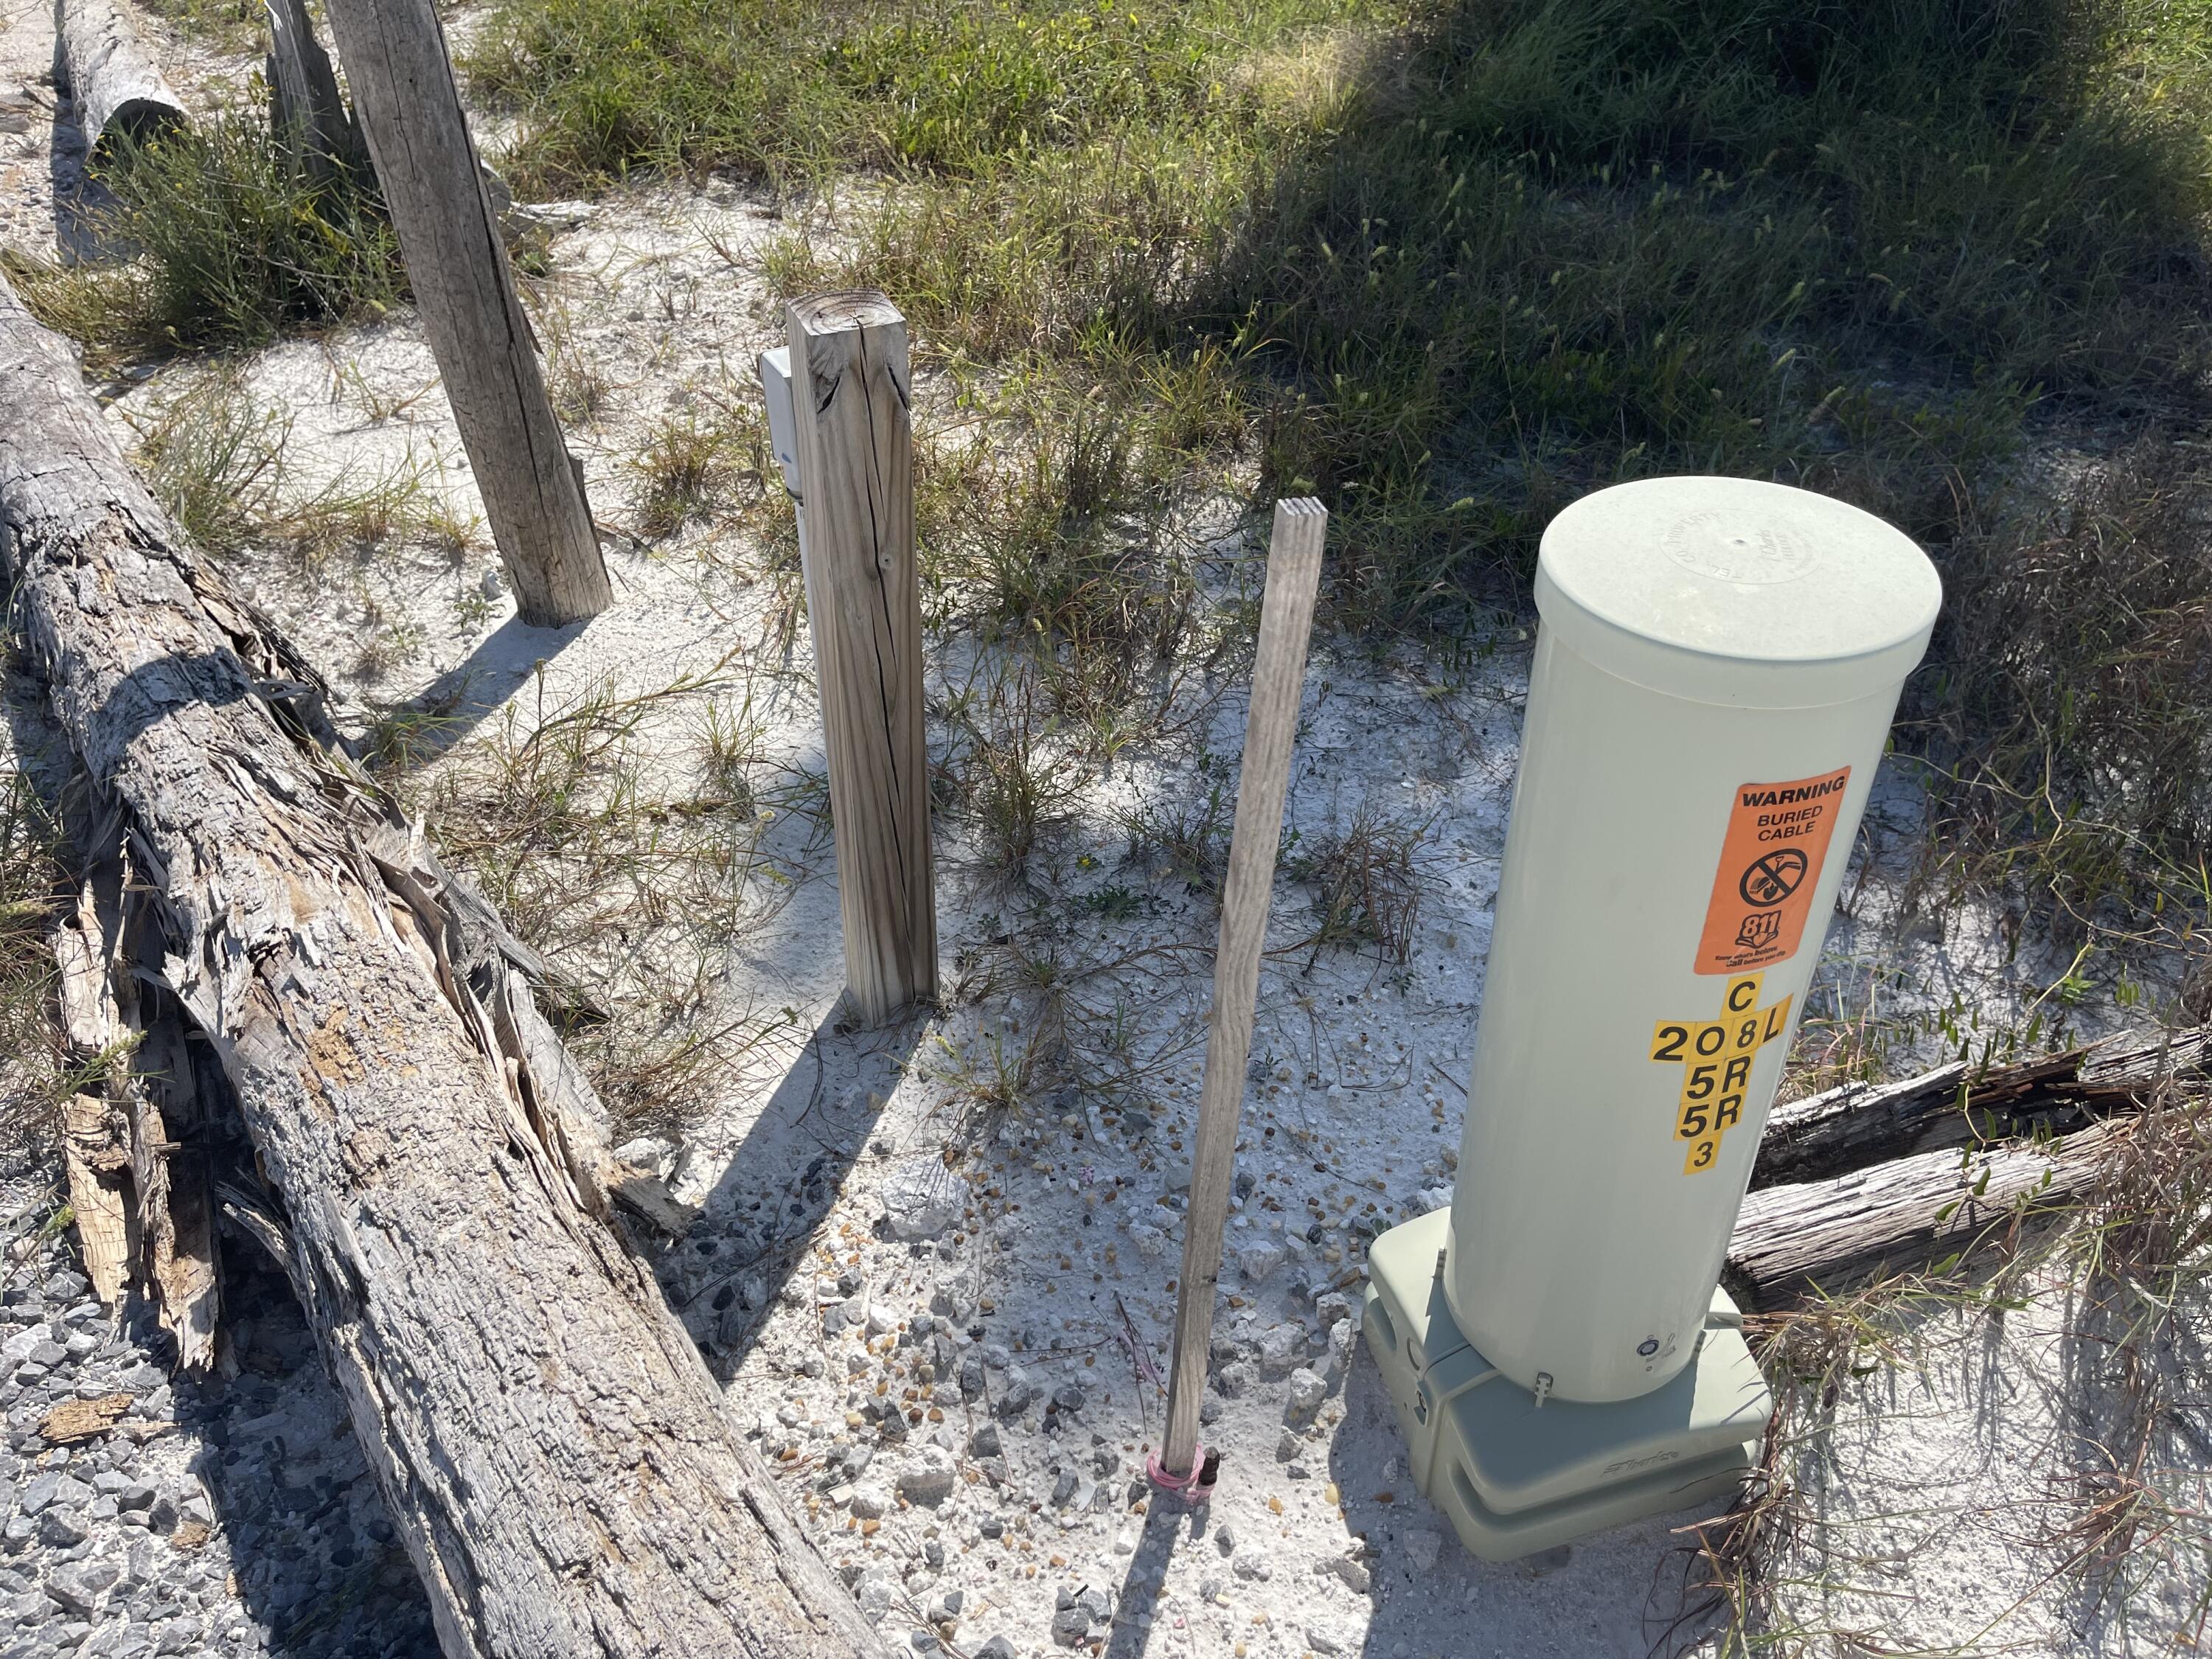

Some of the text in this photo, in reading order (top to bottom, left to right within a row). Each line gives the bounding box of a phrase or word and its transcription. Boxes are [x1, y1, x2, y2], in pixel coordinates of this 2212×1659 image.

[1743, 776, 1845, 807] WARNING
[1757, 806, 1823, 827] BURIED
[1758, 821, 1816, 841] CABLE
[1740, 911, 1782, 938] 811
[1743, 957, 1764, 965] before
[1728, 981, 1756, 1012] C
[1687, 1056, 1750, 1099] 5R
[1680, 1094, 1742, 1138] 5R
[1694, 1141, 1714, 1166] 3
